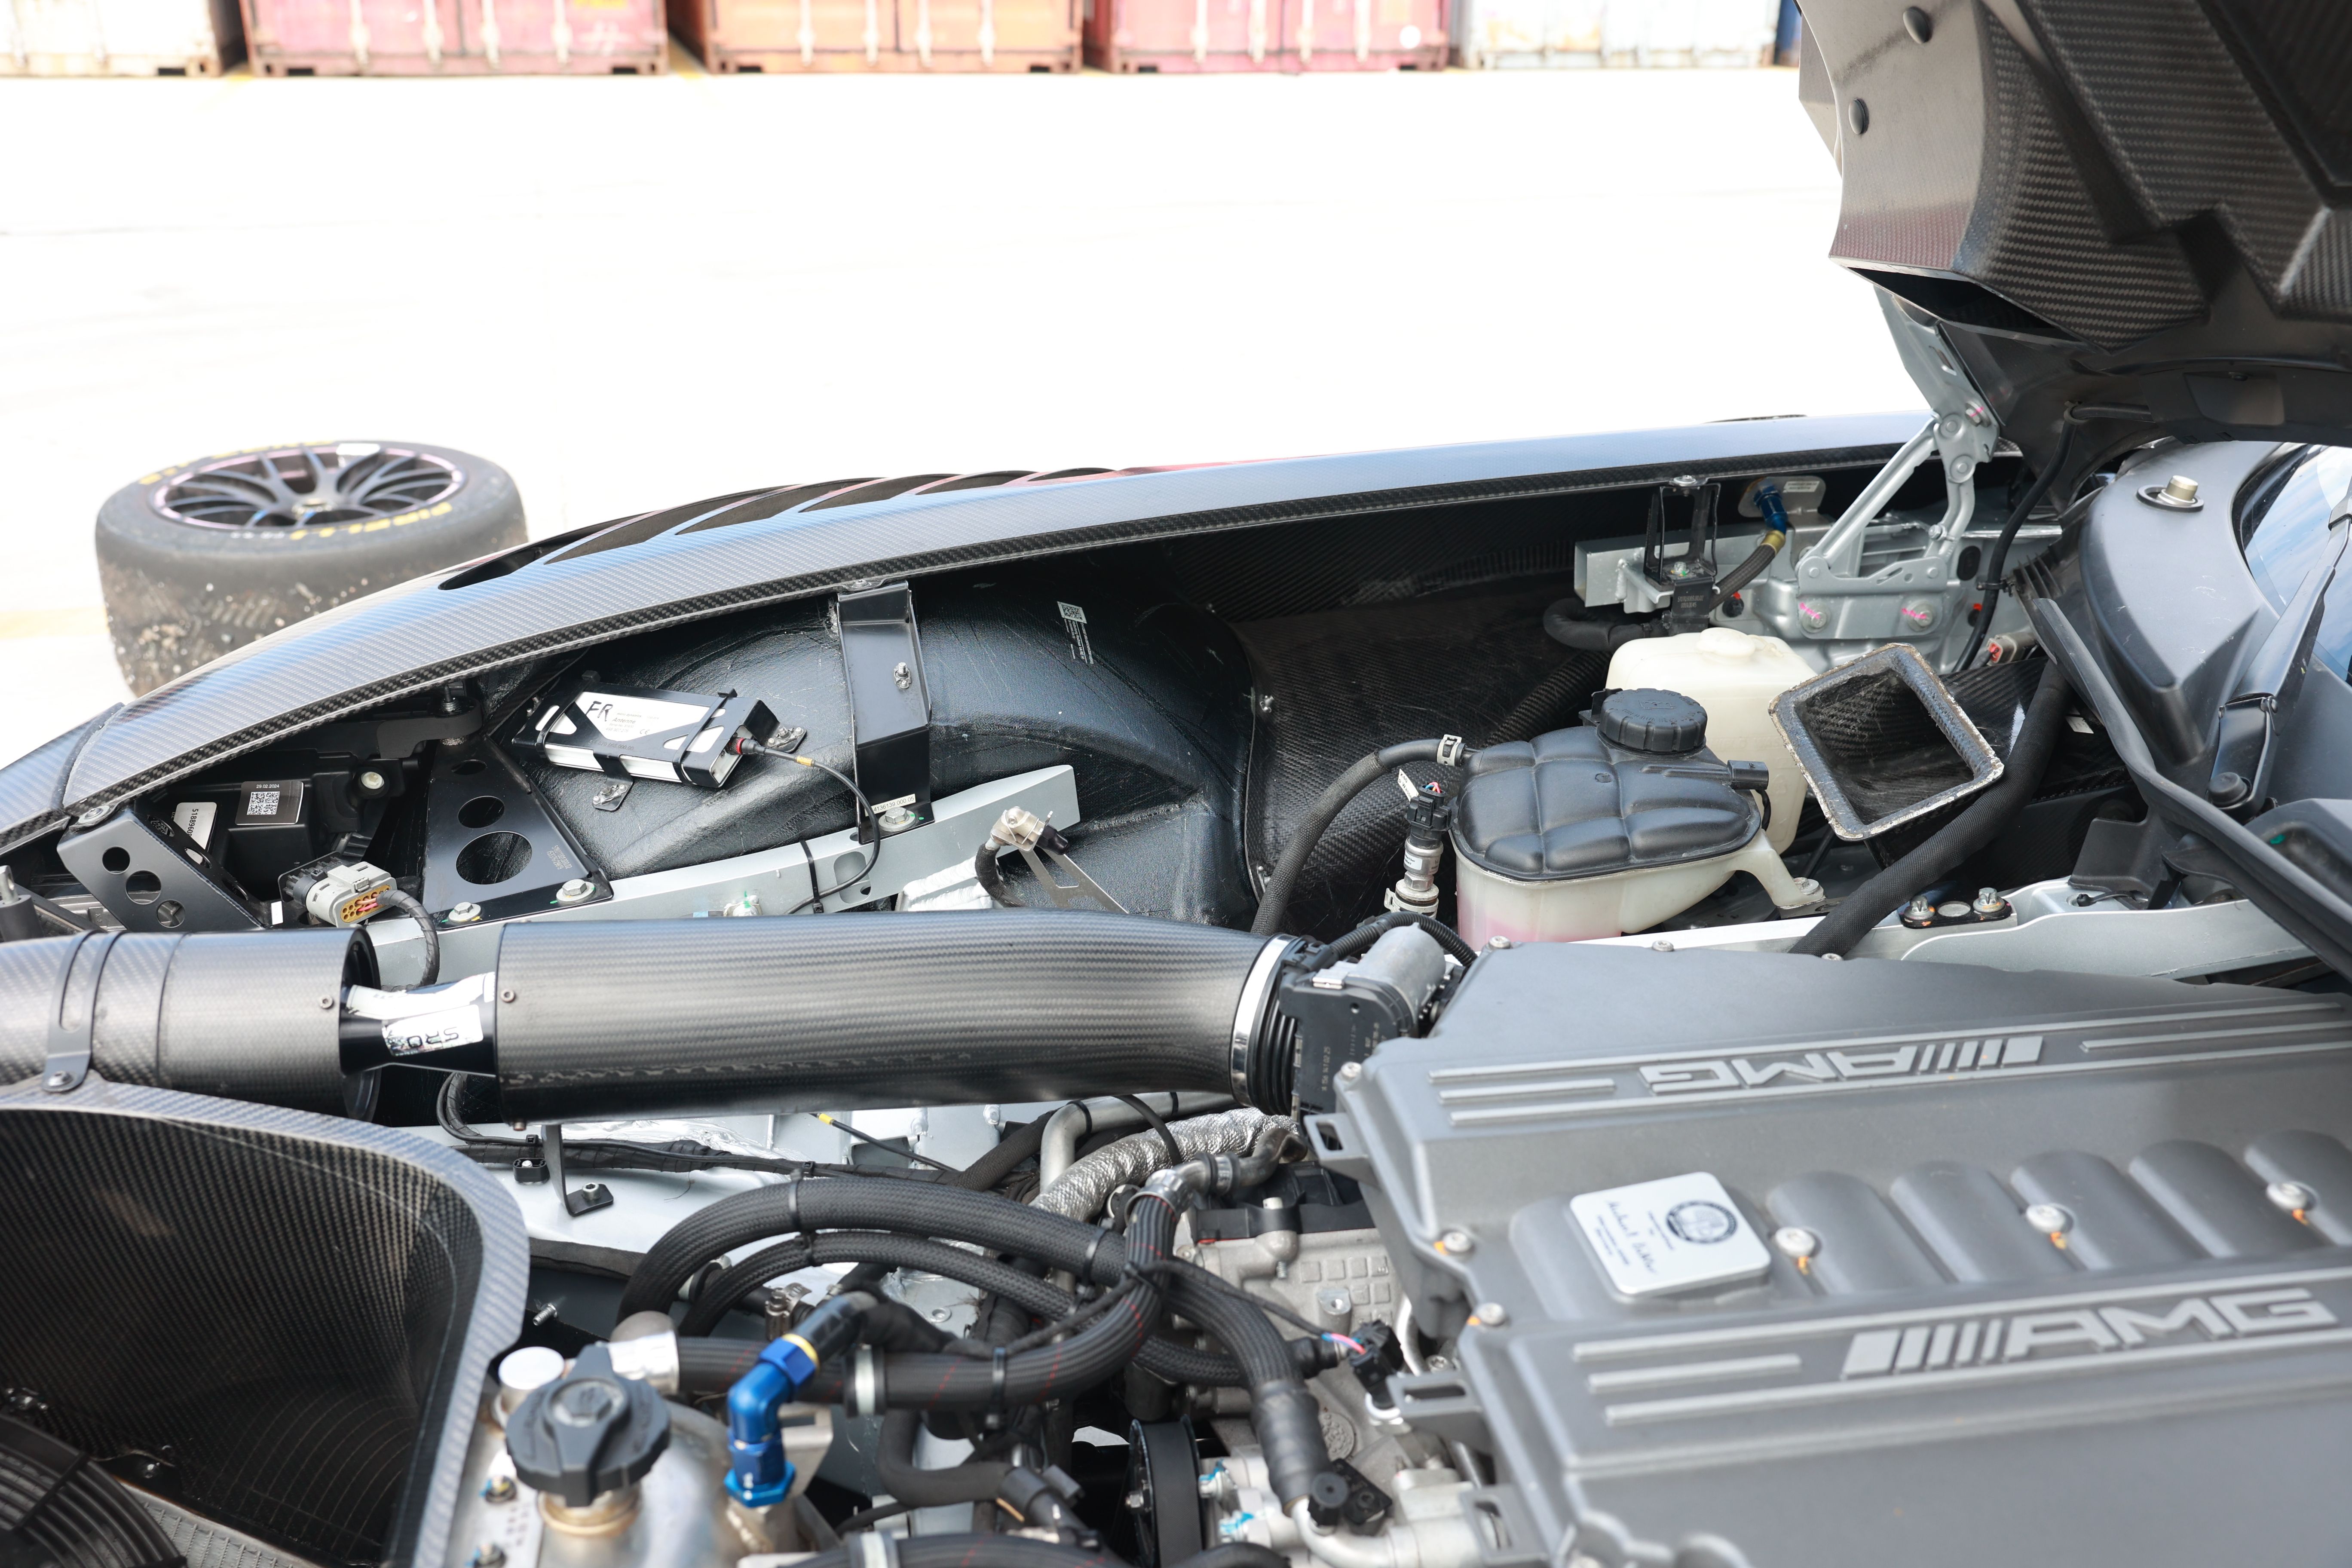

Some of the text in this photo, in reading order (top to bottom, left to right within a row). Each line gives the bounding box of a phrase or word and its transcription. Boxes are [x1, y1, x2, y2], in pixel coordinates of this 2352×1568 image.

[585, 701, 613, 722] FR
[1638, 1045, 1918, 1093] AMG
[2003, 1289, 2339, 1361] AMG
